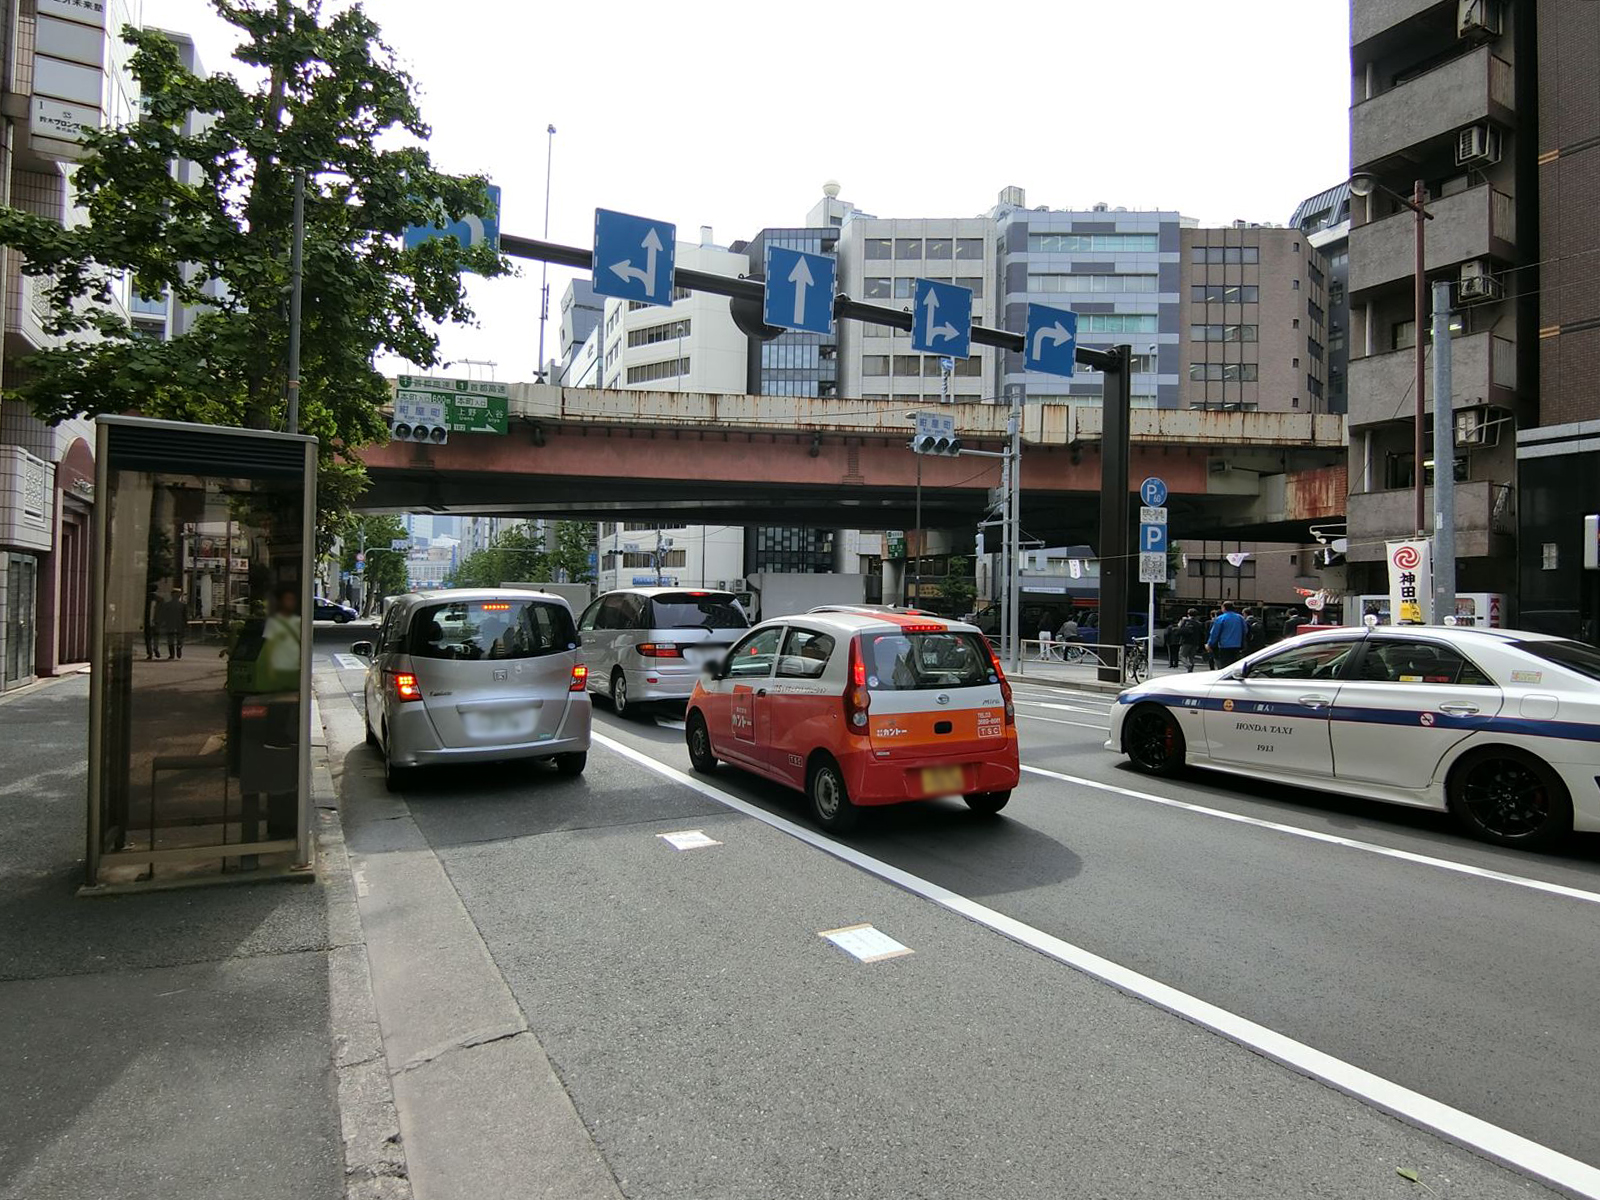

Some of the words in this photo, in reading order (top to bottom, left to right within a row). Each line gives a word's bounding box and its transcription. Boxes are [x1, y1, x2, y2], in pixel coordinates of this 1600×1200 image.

[54, 0, 103, 12] 未来塾
[470, 383, 506, 394] 首都高速
[456, 396, 486, 407] 本町入口
[457, 408, 477, 417] 上野
[485, 409, 504, 419] 入谷
[1146, 484, 1158, 503] P
[1153, 494, 1162, 503] 60
[1146, 526, 1162, 550] P
[980, 728, 999, 736] TSC
[1235, 721, 1267, 733] HONDA
[1269, 725, 1293, 736] TAXI
[1257, 743, 1274, 753] 1913
